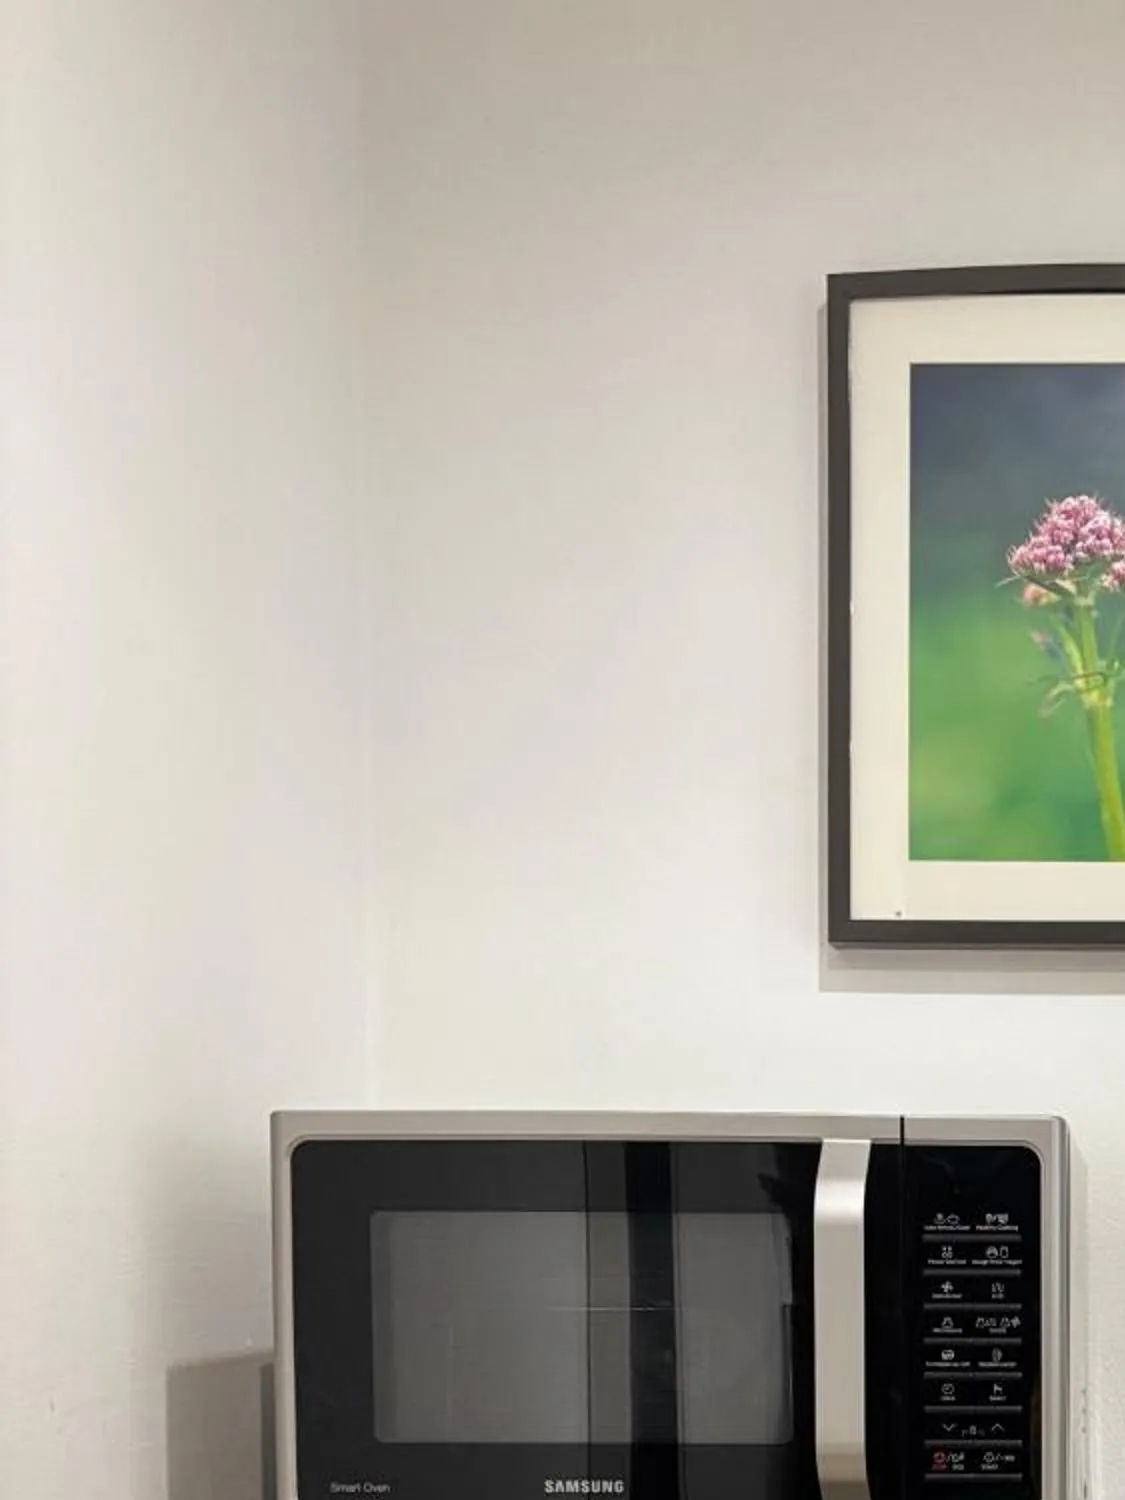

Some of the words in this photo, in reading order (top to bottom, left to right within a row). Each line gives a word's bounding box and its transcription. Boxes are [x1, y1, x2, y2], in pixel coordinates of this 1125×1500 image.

[330, 1481, 360, 1493] Smart
[363, 1481, 391, 1493] Oven
[543, 1479, 624, 1493] SAMSUNG
